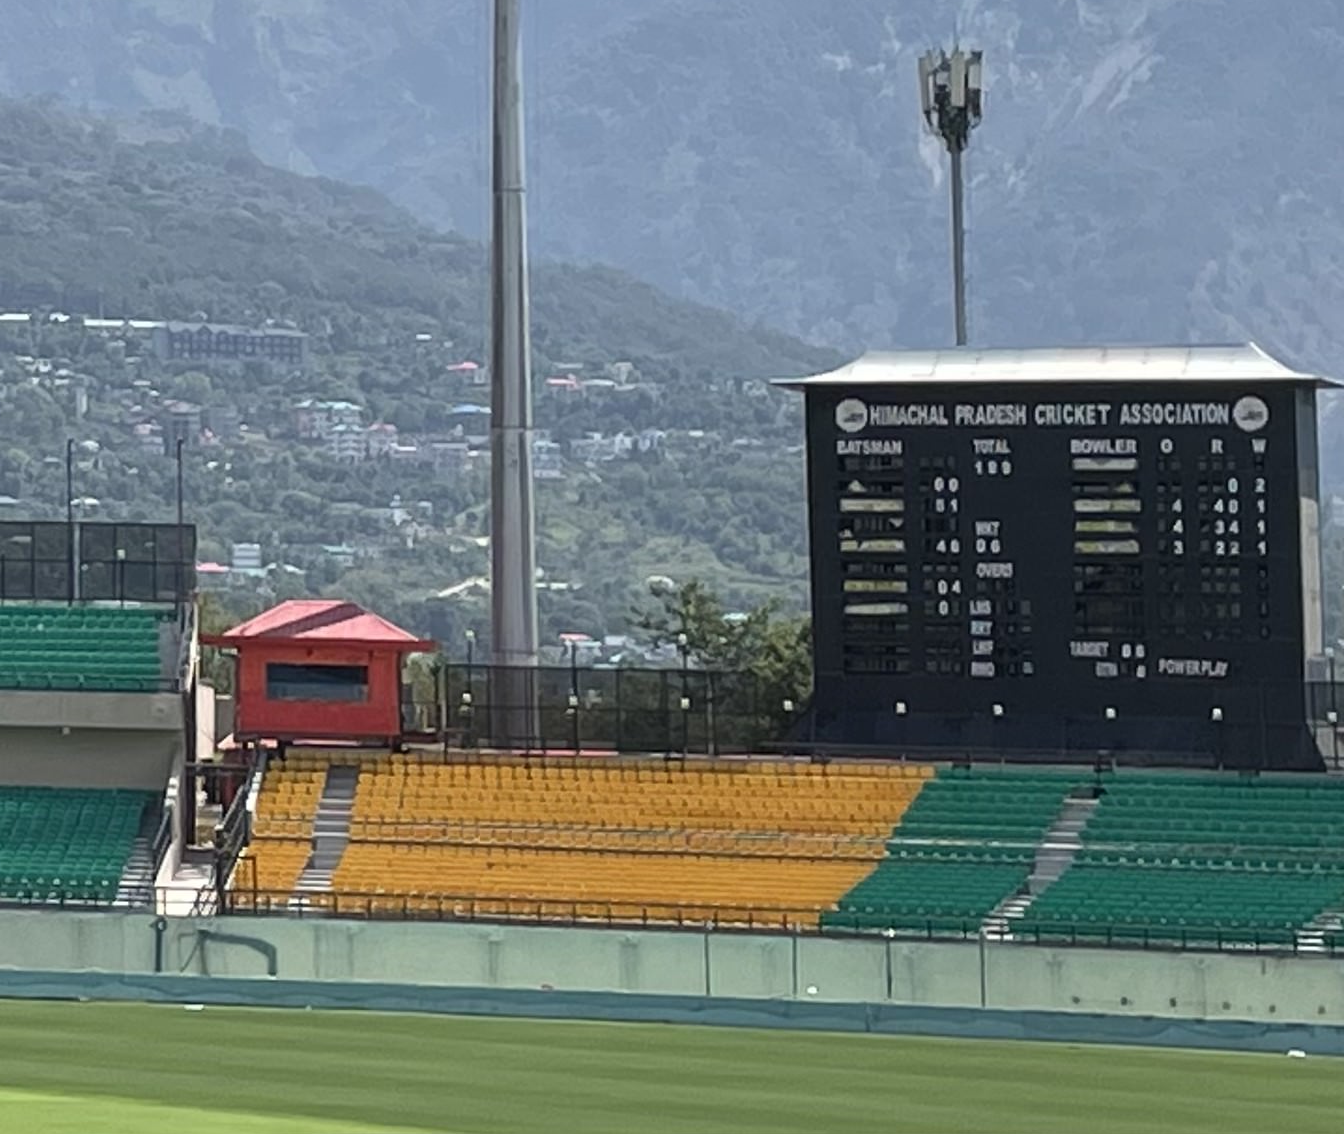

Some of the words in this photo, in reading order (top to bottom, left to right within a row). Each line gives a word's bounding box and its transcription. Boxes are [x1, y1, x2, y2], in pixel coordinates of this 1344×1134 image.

[870, 404, 949, 426] HIMACHAL
[955, 404, 1027, 425] PRADESH
[1034, 404, 1112, 425] CRICKET
[1120, 402, 1229, 425] ASSOCIATION
[836, 440, 902, 455] BATSMAN
[973, 439, 1011, 454] TOTAL
[1070, 438, 1137, 454] BOWLER
[1160, 438, 1173, 454] O
[1211, 439, 1223, 454] R
[1251, 438, 1266, 453] W
[1227, 477, 1238, 493] 0
[1255, 477, 1265, 493] 2
[1172, 498, 1182, 513] 4
[1257, 499, 1265, 513] 1
[1173, 519, 1184, 534] 4
[1257, 520, 1265, 534] 1
[1173, 540, 1184, 555] 3
[1257, 541, 1266, 555] 1
[938, 600, 949, 616] 0
